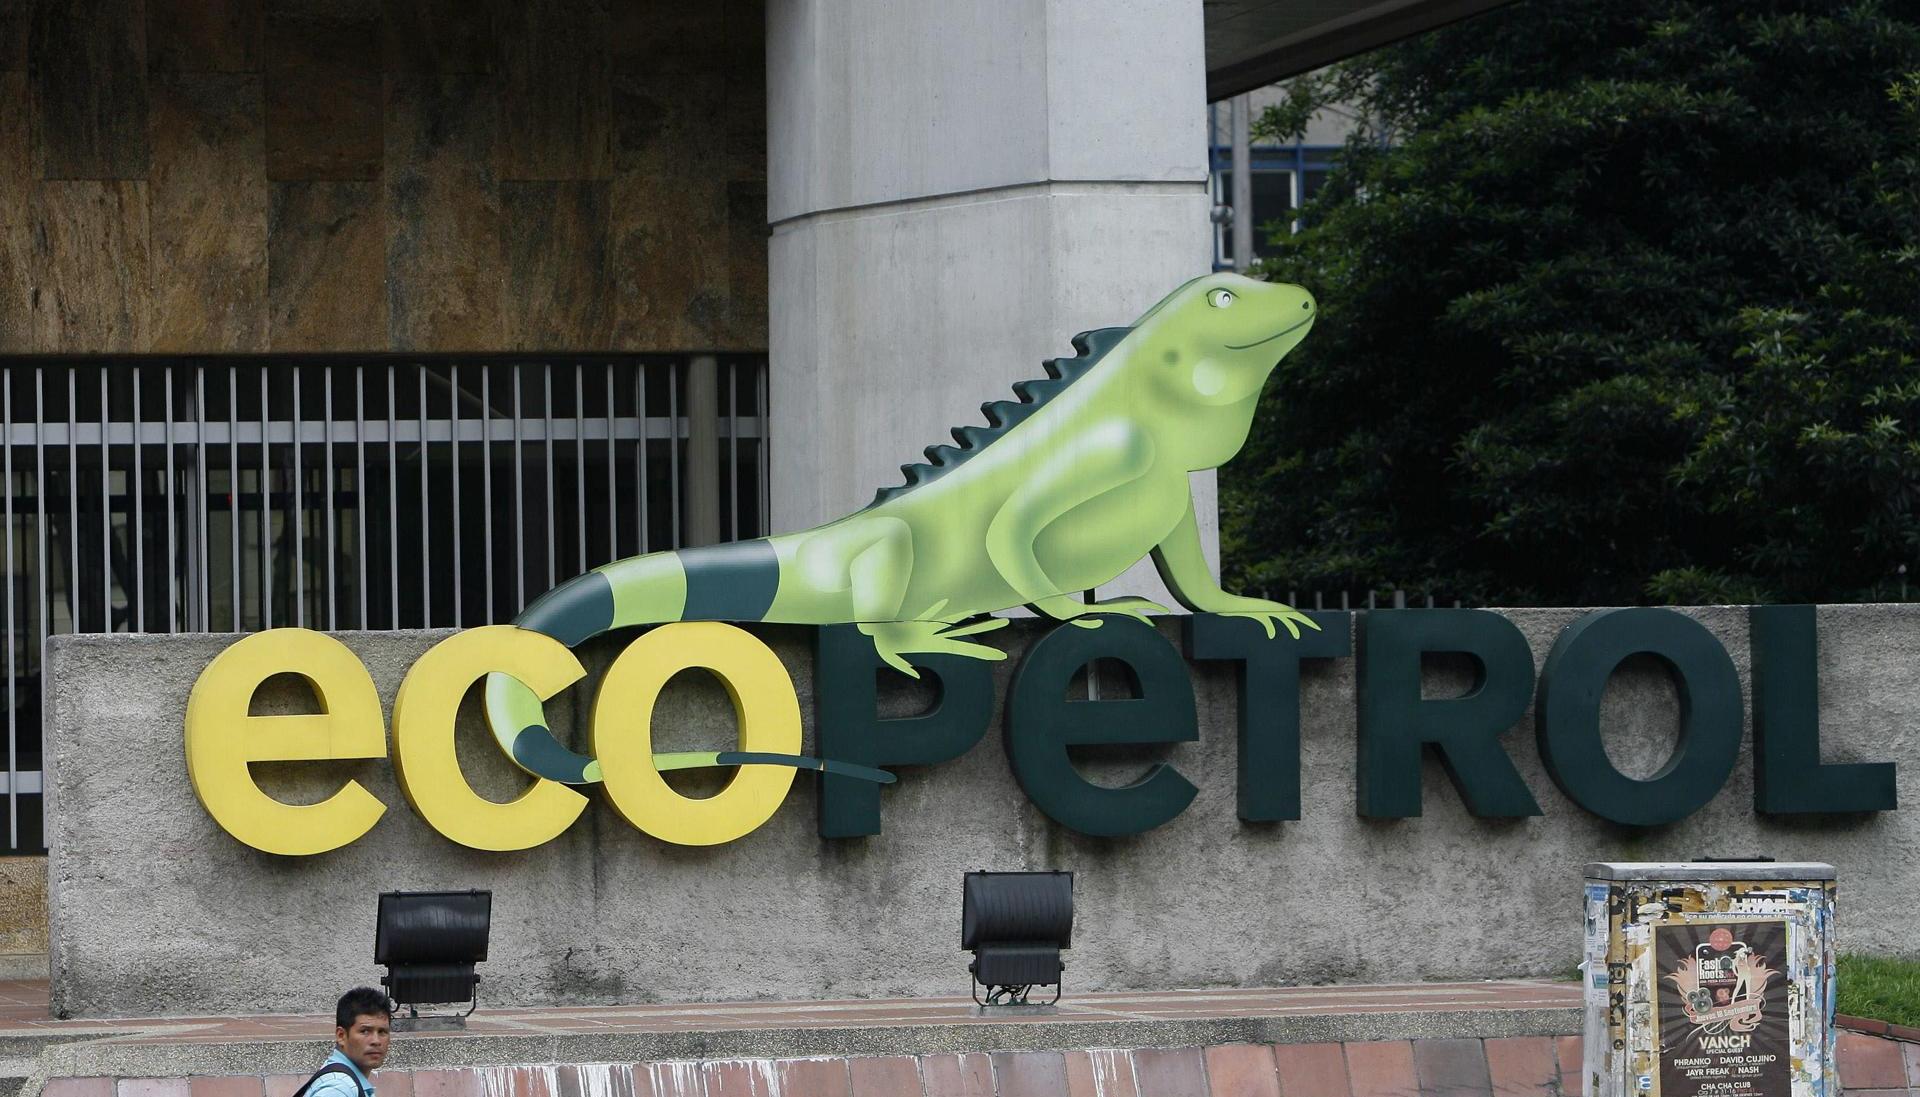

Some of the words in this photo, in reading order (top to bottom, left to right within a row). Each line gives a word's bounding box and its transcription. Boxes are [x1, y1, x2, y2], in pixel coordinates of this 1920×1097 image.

[1699, 1035, 1751, 1049] VANCH
[1674, 1058, 1711, 1067] PHRANKO
[1720, 1056, 1744, 1064] DAVID
[1685, 1068, 1704, 1077] JAYR
[1706, 1067, 1730, 1075] FREAK
[1738, 1066, 1760, 1074] NASH
[1701, 1083, 1716, 1091] CHA
[1717, 1082, 1733, 1090] CHA
[1734, 1081, 1751, 1089] CLUB
